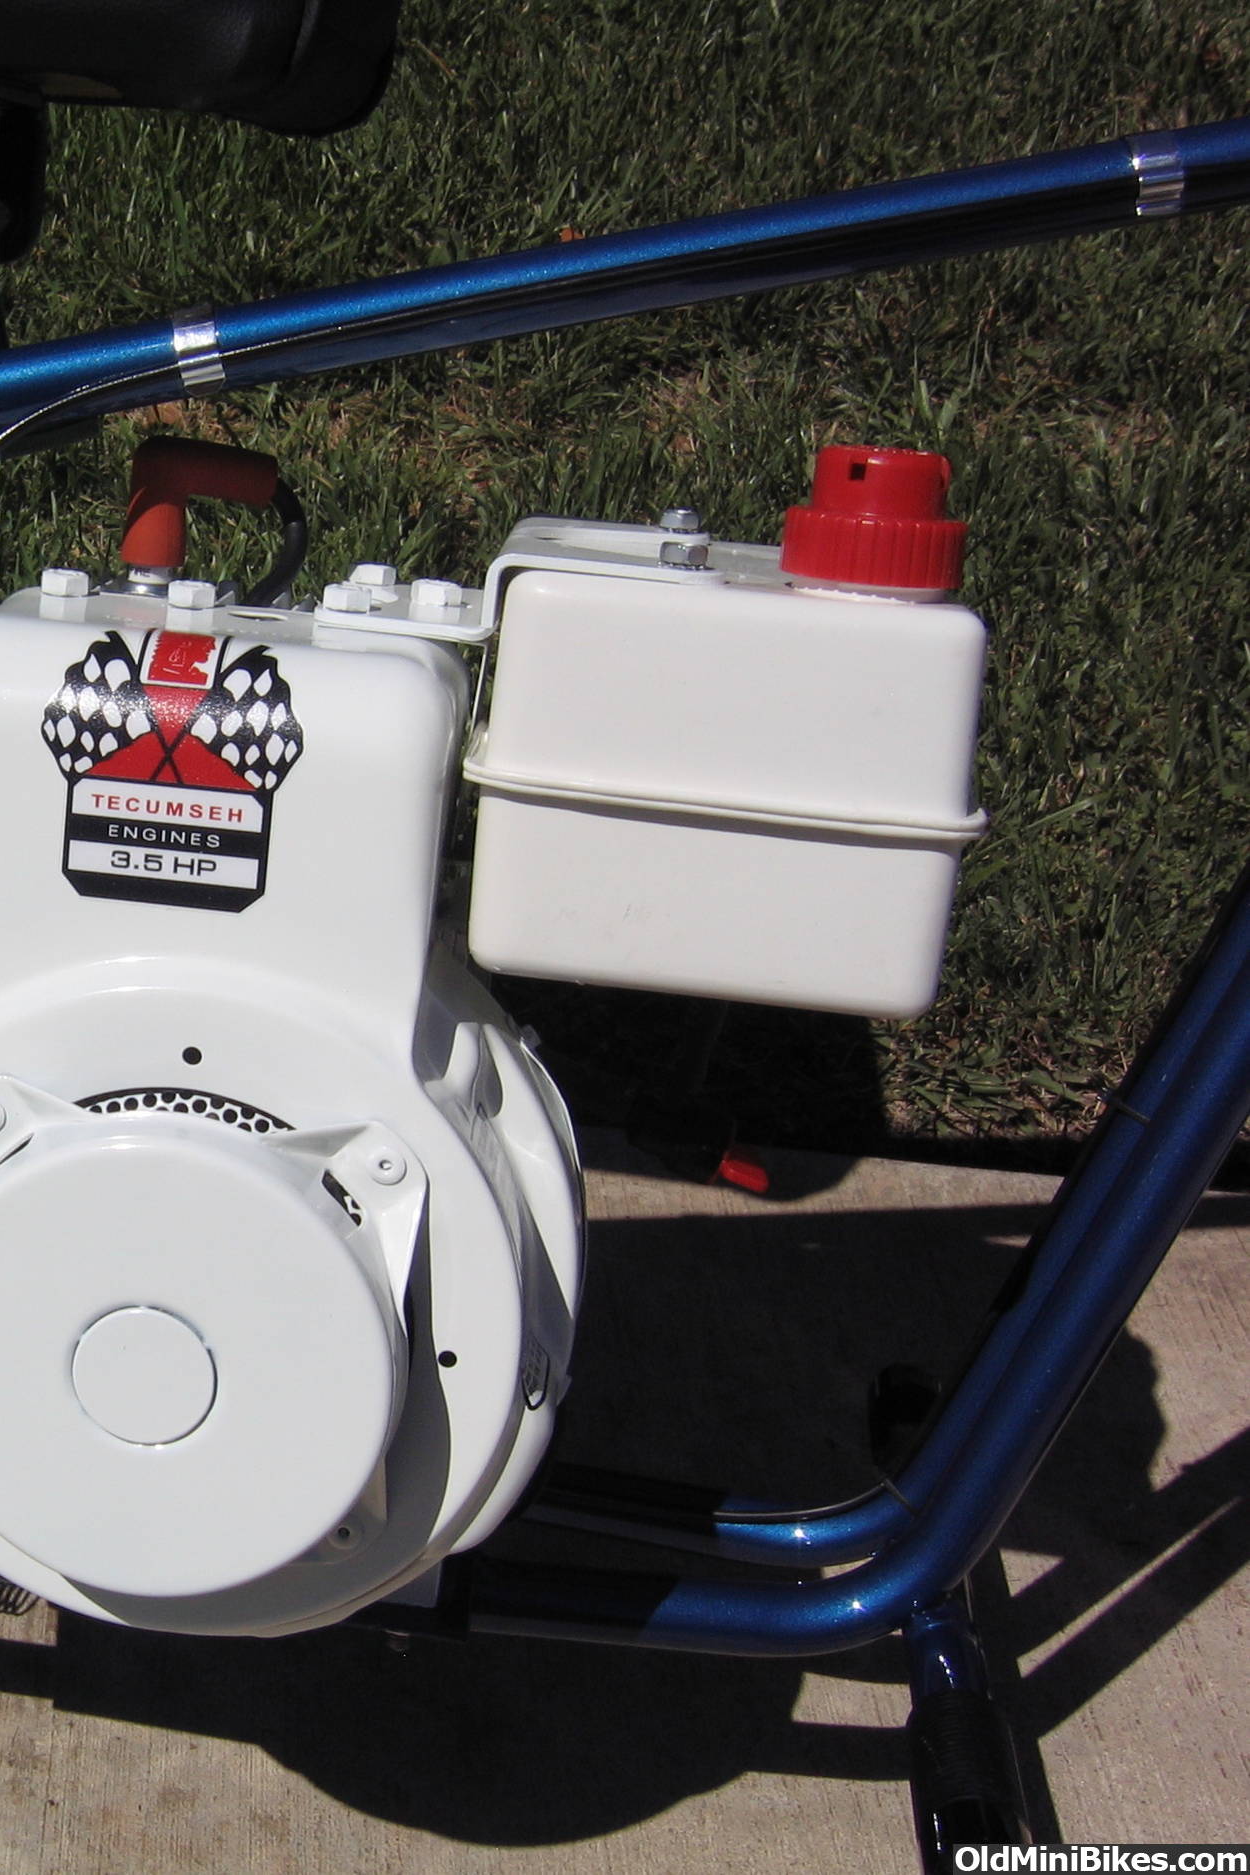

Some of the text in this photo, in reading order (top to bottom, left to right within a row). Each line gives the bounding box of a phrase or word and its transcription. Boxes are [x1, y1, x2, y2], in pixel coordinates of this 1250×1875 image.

[91, 793, 243, 823] TECUMSEH
[108, 824, 221, 848] ENGINES
[110, 850, 218, 876] 3.5 HP
